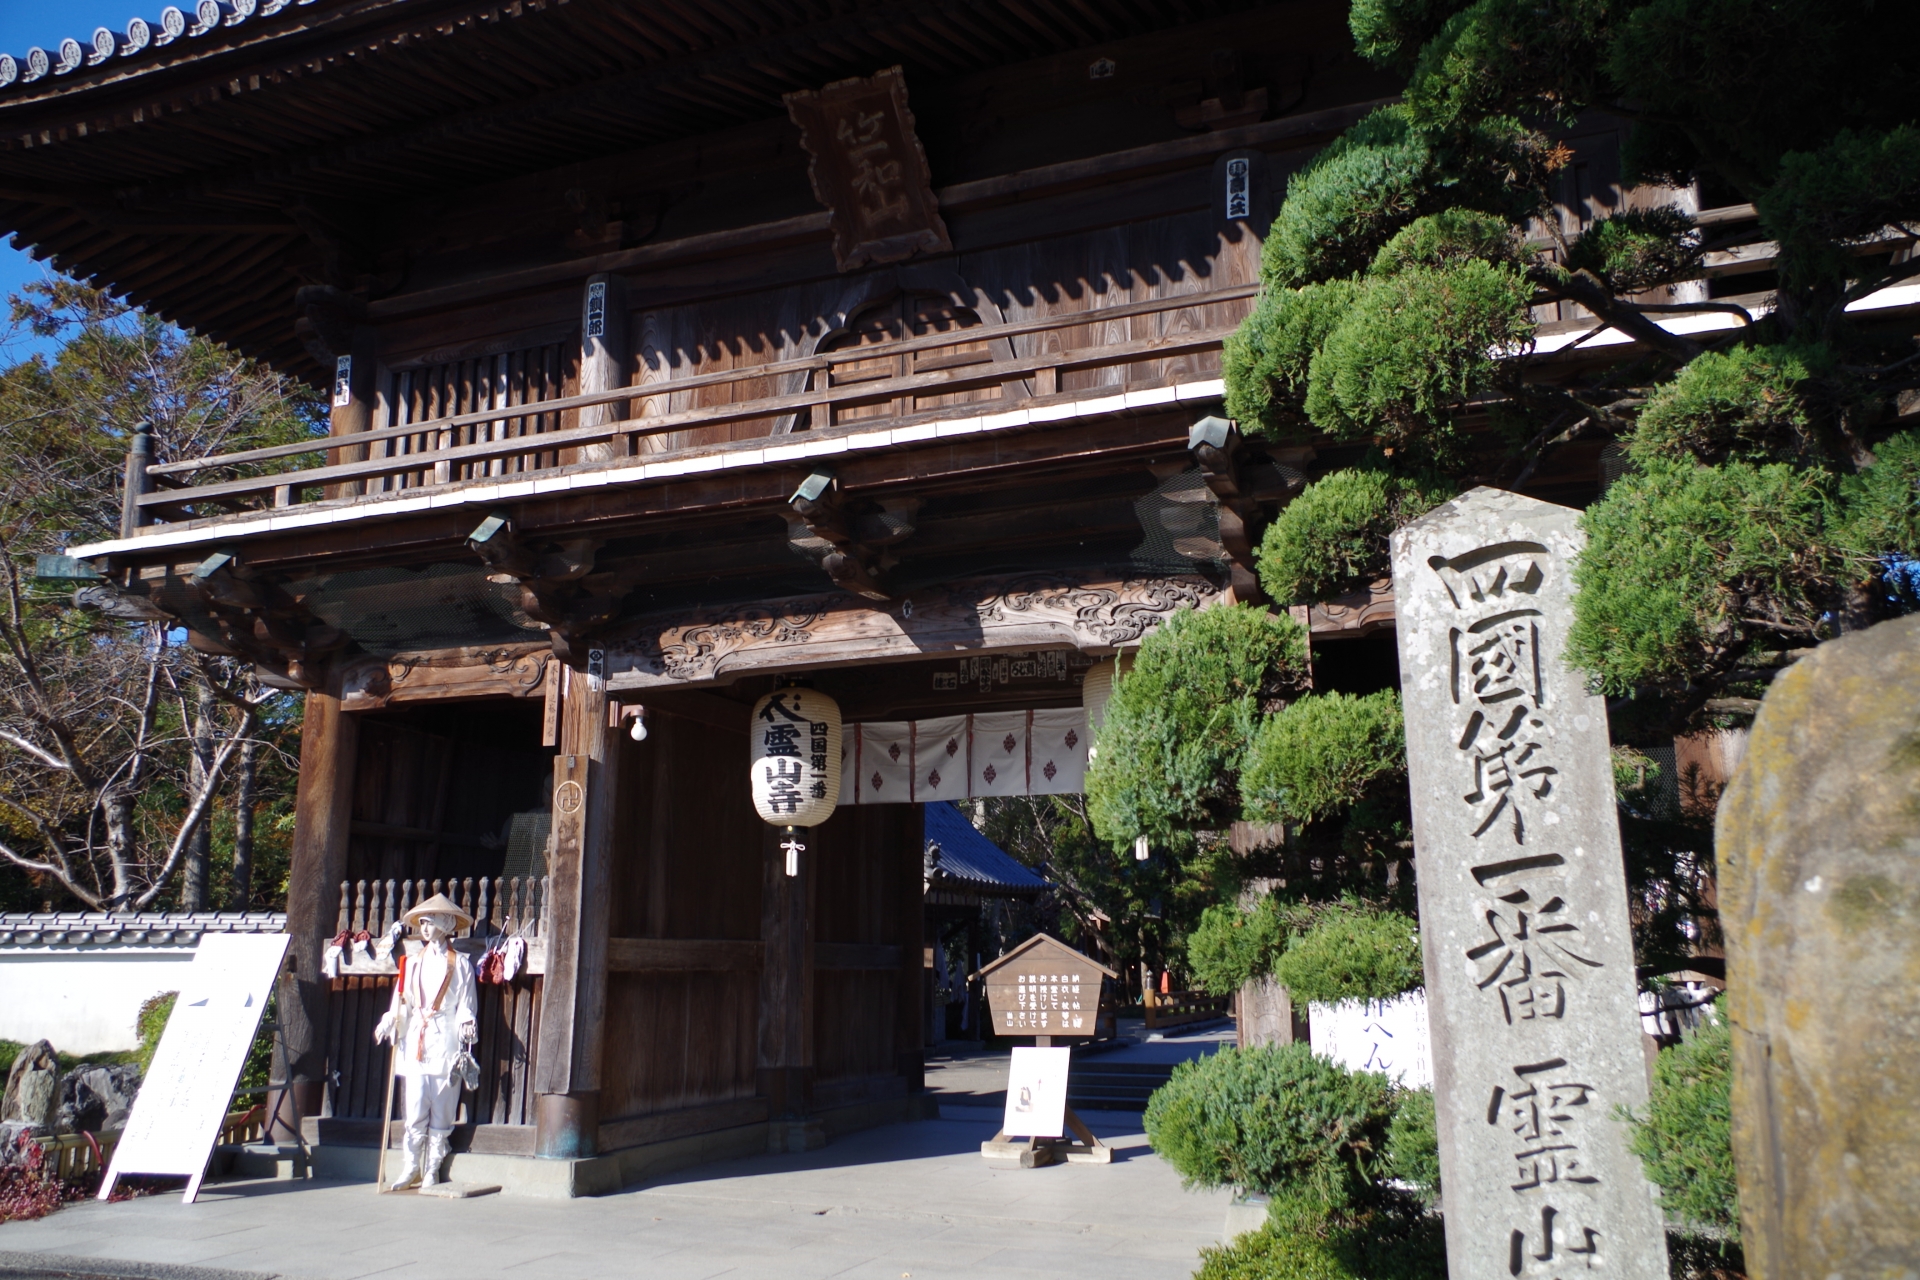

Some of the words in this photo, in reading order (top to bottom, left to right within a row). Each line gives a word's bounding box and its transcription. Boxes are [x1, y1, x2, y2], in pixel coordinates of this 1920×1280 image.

[809, 721, 829, 800] 四国第一番
[1039, 974, 1048, 1028] お授けします
